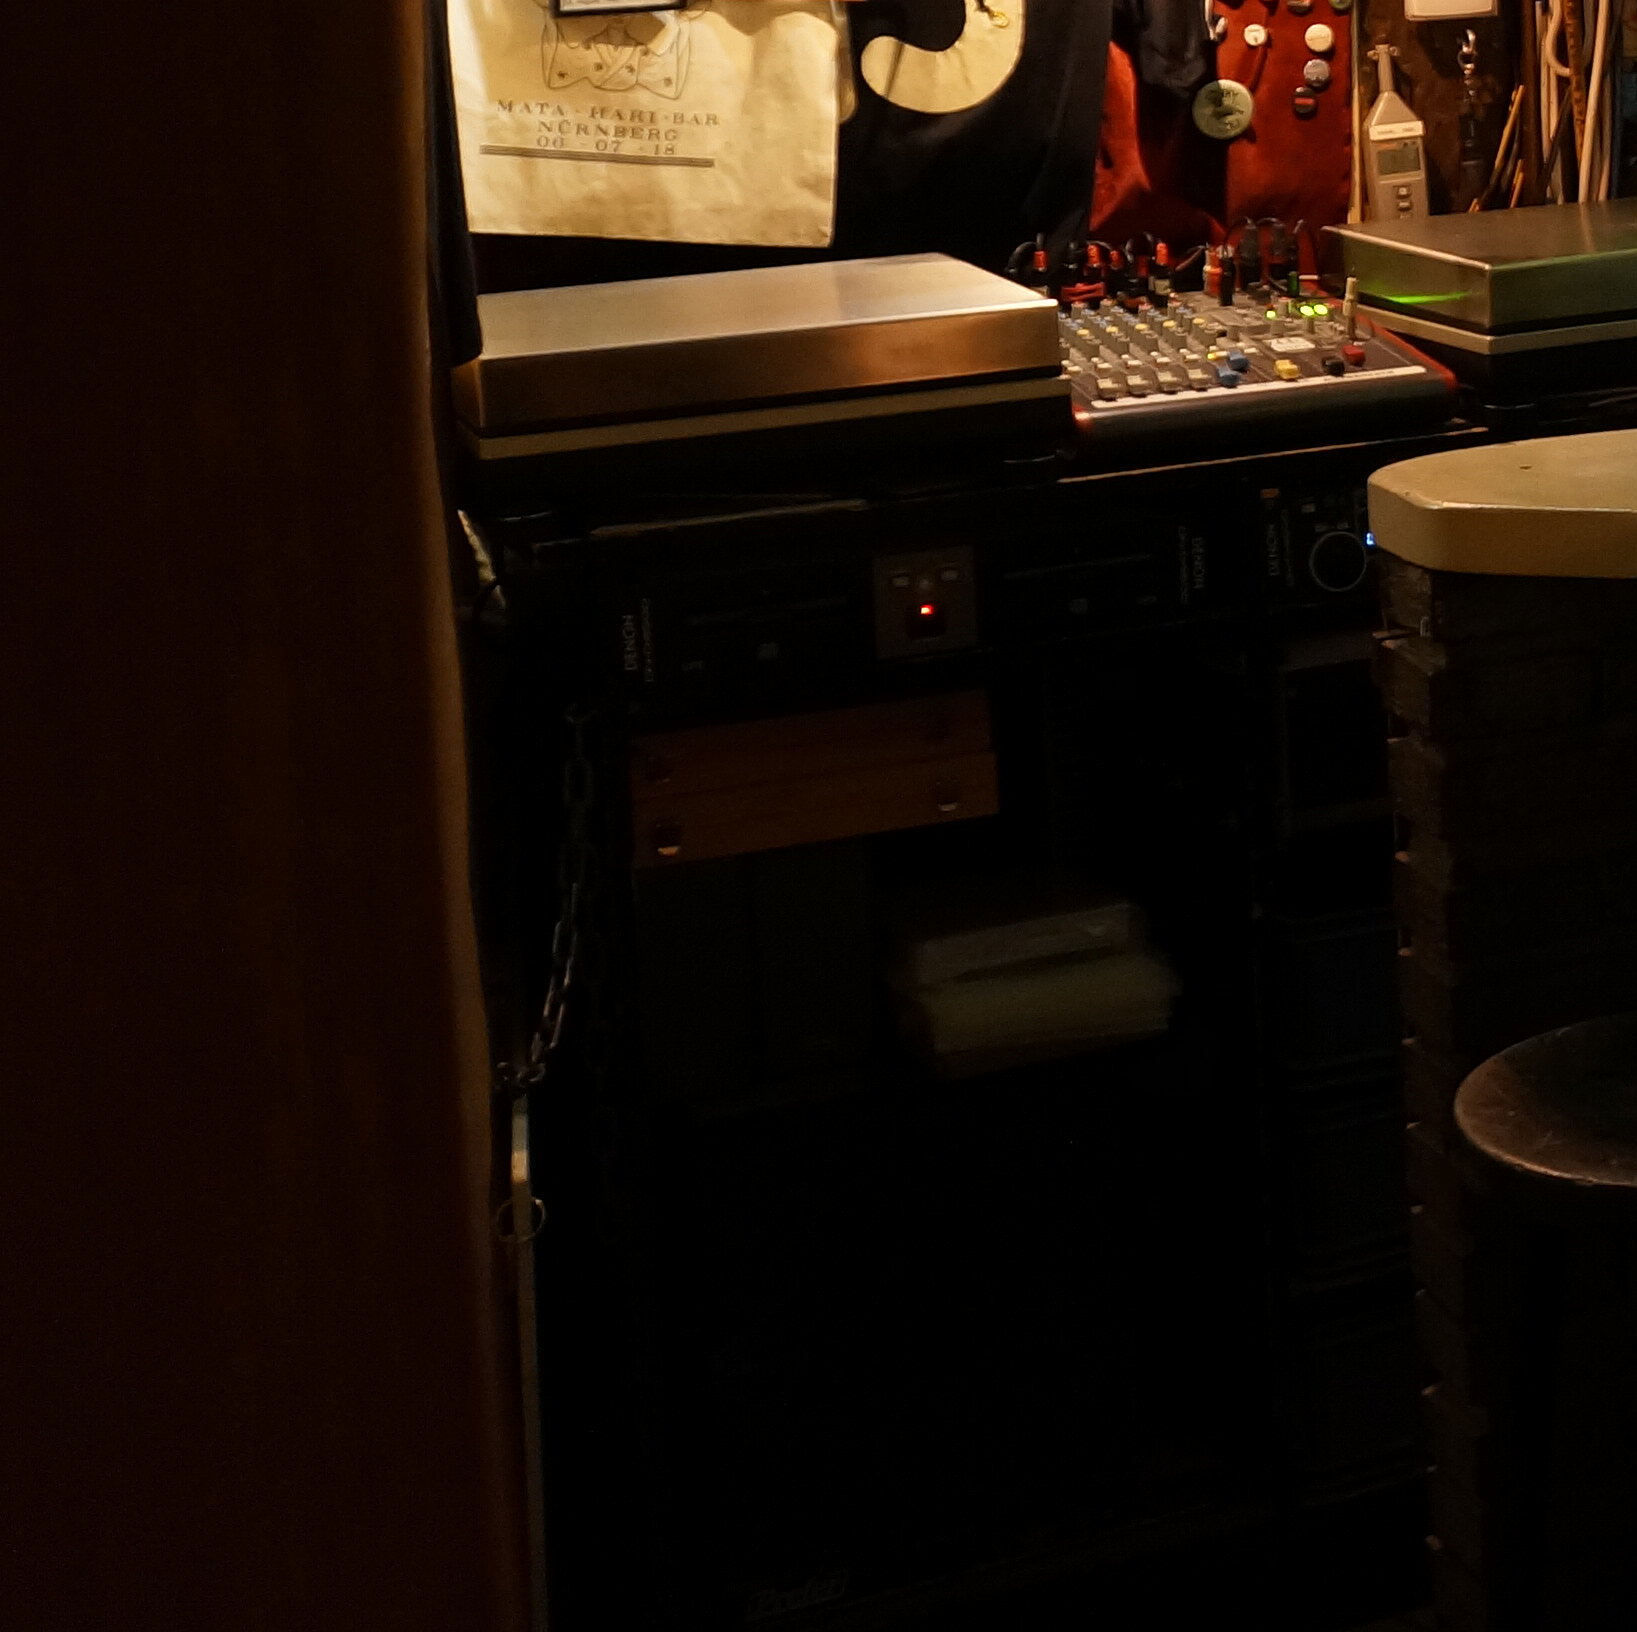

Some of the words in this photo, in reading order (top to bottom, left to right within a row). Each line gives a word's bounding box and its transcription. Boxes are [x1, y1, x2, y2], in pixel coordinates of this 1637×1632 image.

[496, 99, 566, 116] MATA
[589, 104, 660, 124] HARI
[671, 111, 721, 126] BAR
